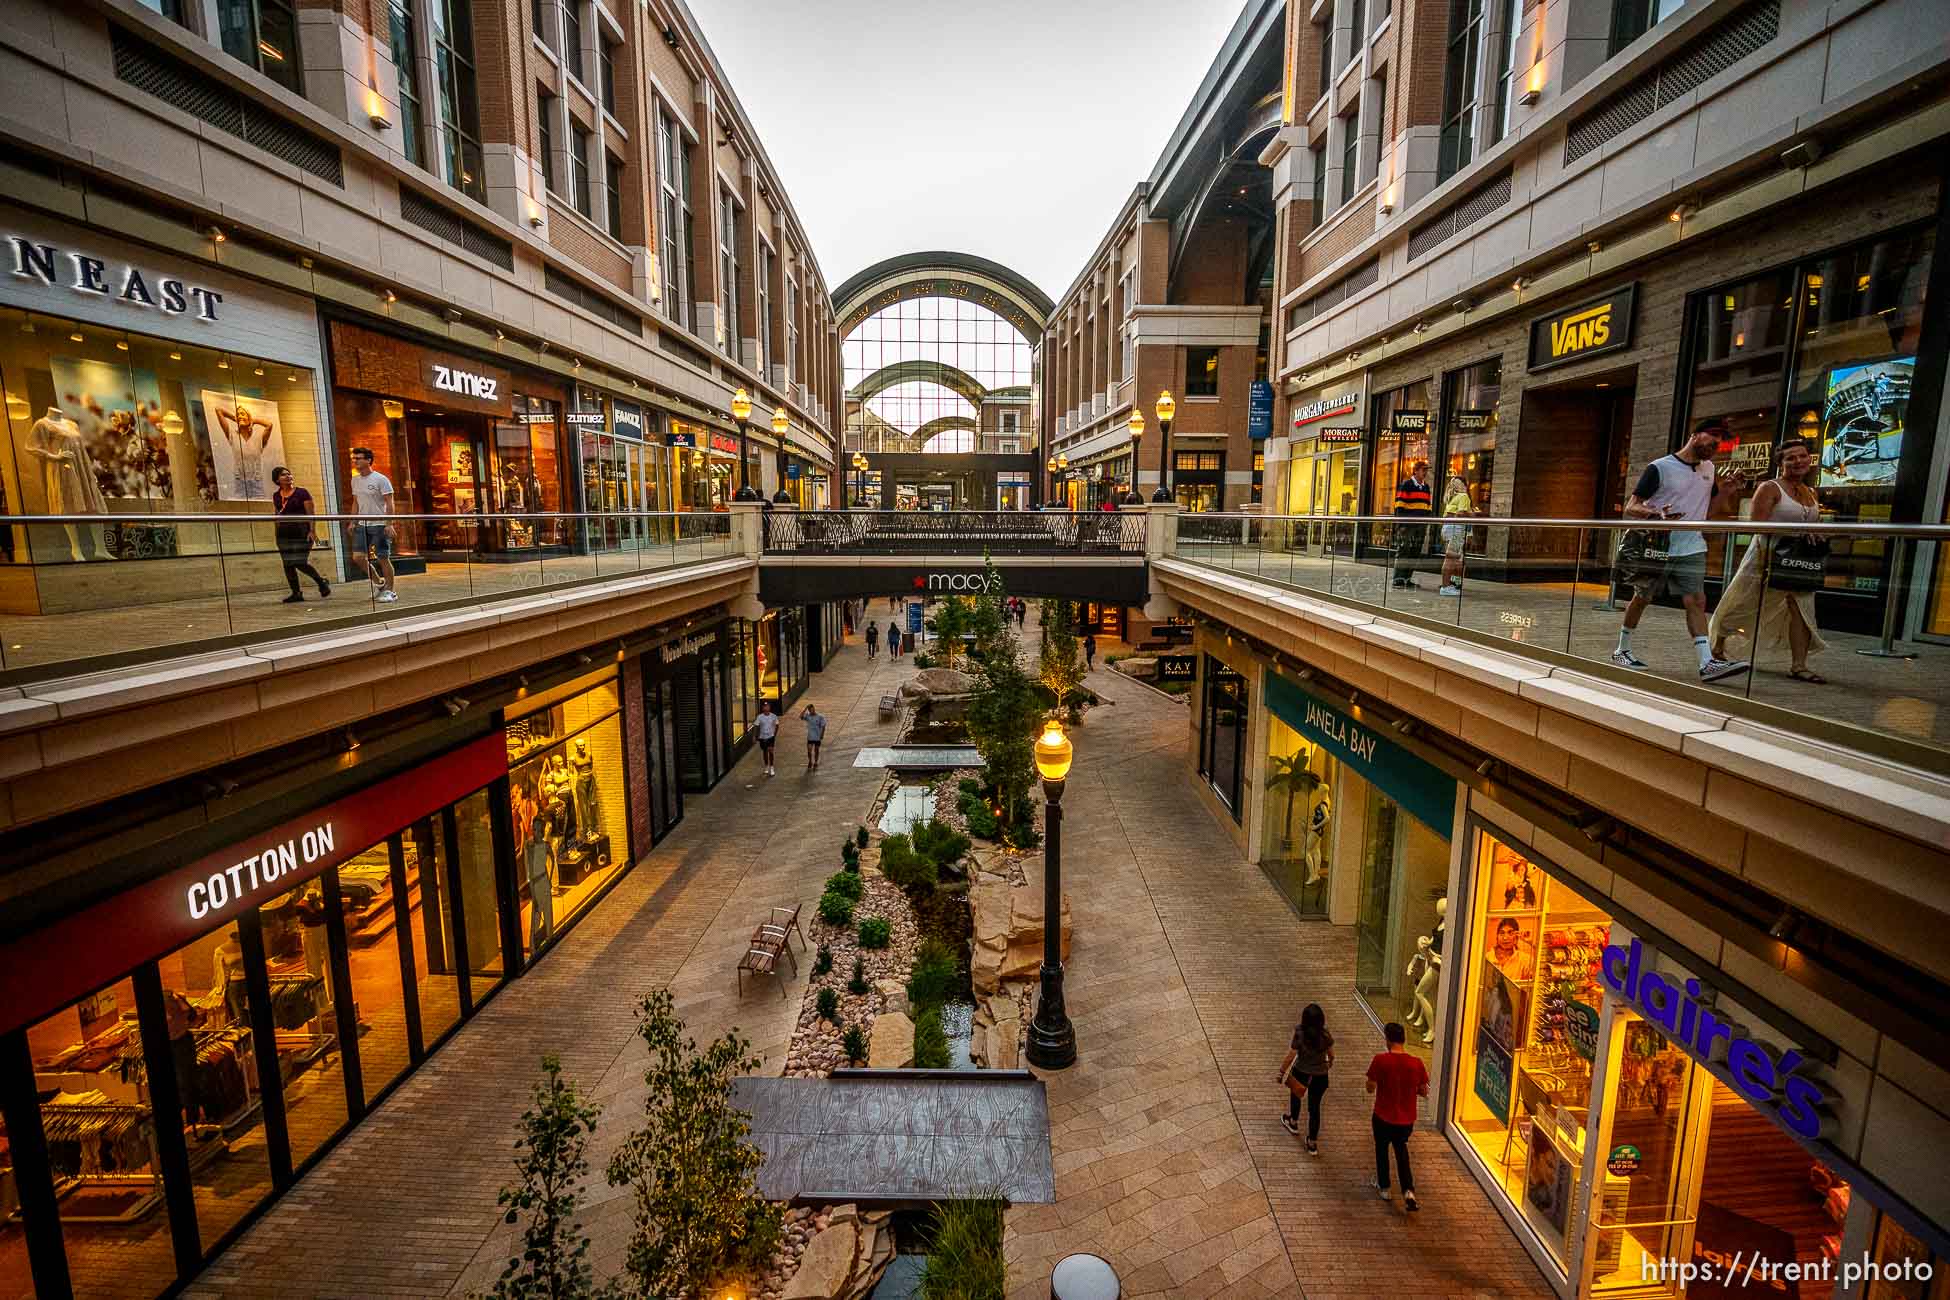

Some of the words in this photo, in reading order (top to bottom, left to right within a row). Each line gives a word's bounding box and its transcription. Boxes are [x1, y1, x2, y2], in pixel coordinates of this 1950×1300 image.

[1551, 303, 1612, 357] VANS
[432, 365, 498, 400] zumiez
[567, 414, 604, 424] zumiez
[1294, 400, 1324, 422] MORGAN
[1323, 393, 1358, 412] JEWELERS
[1395, 415, 1425, 428] VANS
[1164, 661, 1191, 671] KAY
[1305, 700, 1347, 747] JANELA
[1350, 727, 1377, 764] BAY
[187, 839, 298, 920] COTTON
[301, 821, 335, 863] ON
[1602, 937, 1824, 1138] claire's
